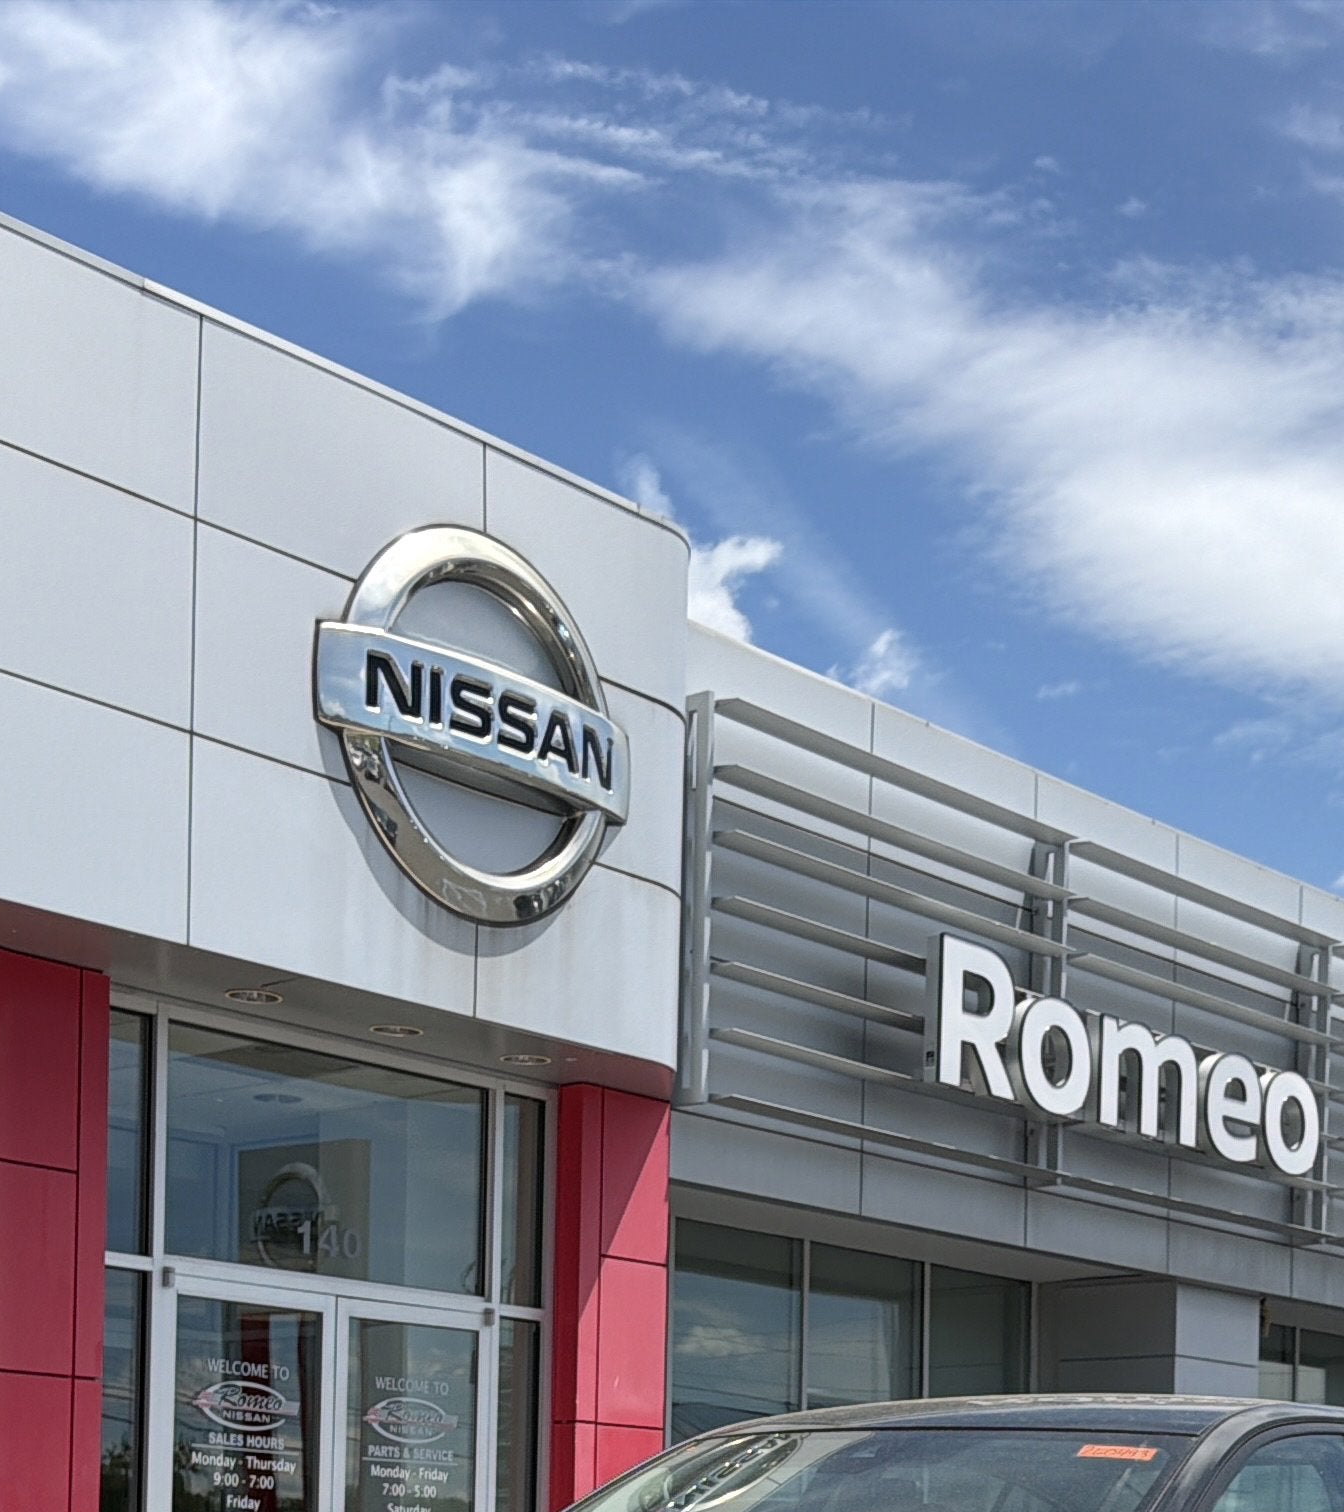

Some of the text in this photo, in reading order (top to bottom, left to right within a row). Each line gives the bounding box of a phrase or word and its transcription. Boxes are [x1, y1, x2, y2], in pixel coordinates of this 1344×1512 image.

[363, 648, 616, 794] NISSAN
[932, 932, 1322, 1177] Romeo
[297, 1220, 362, 1259] 140
[208, 1358, 290, 1381] WELCOME TO
[375, 1376, 449, 1396] WELCOME TO
[214, 1384, 283, 1411] Romeo
[222, 1409, 271, 1423] NISSAN
[208, 1431, 285, 1450] SALES HOURS
[368, 1445, 454, 1461] PARTS & SERVICE
[191, 1451, 236, 1471] Monday
[245, 1455, 297, 1476] Thursday
[370, 1463, 411, 1481] Monday
[418, 1467, 449, 1484] Friday
[213, 1472, 240, 1488] 9:00
[249, 1474, 275, 1490] 7:00
[382, 1482, 406, 1497] 7:00
[414, 1484, 437, 1498] 5:00
[226, 1494, 261, 1512] Friday
